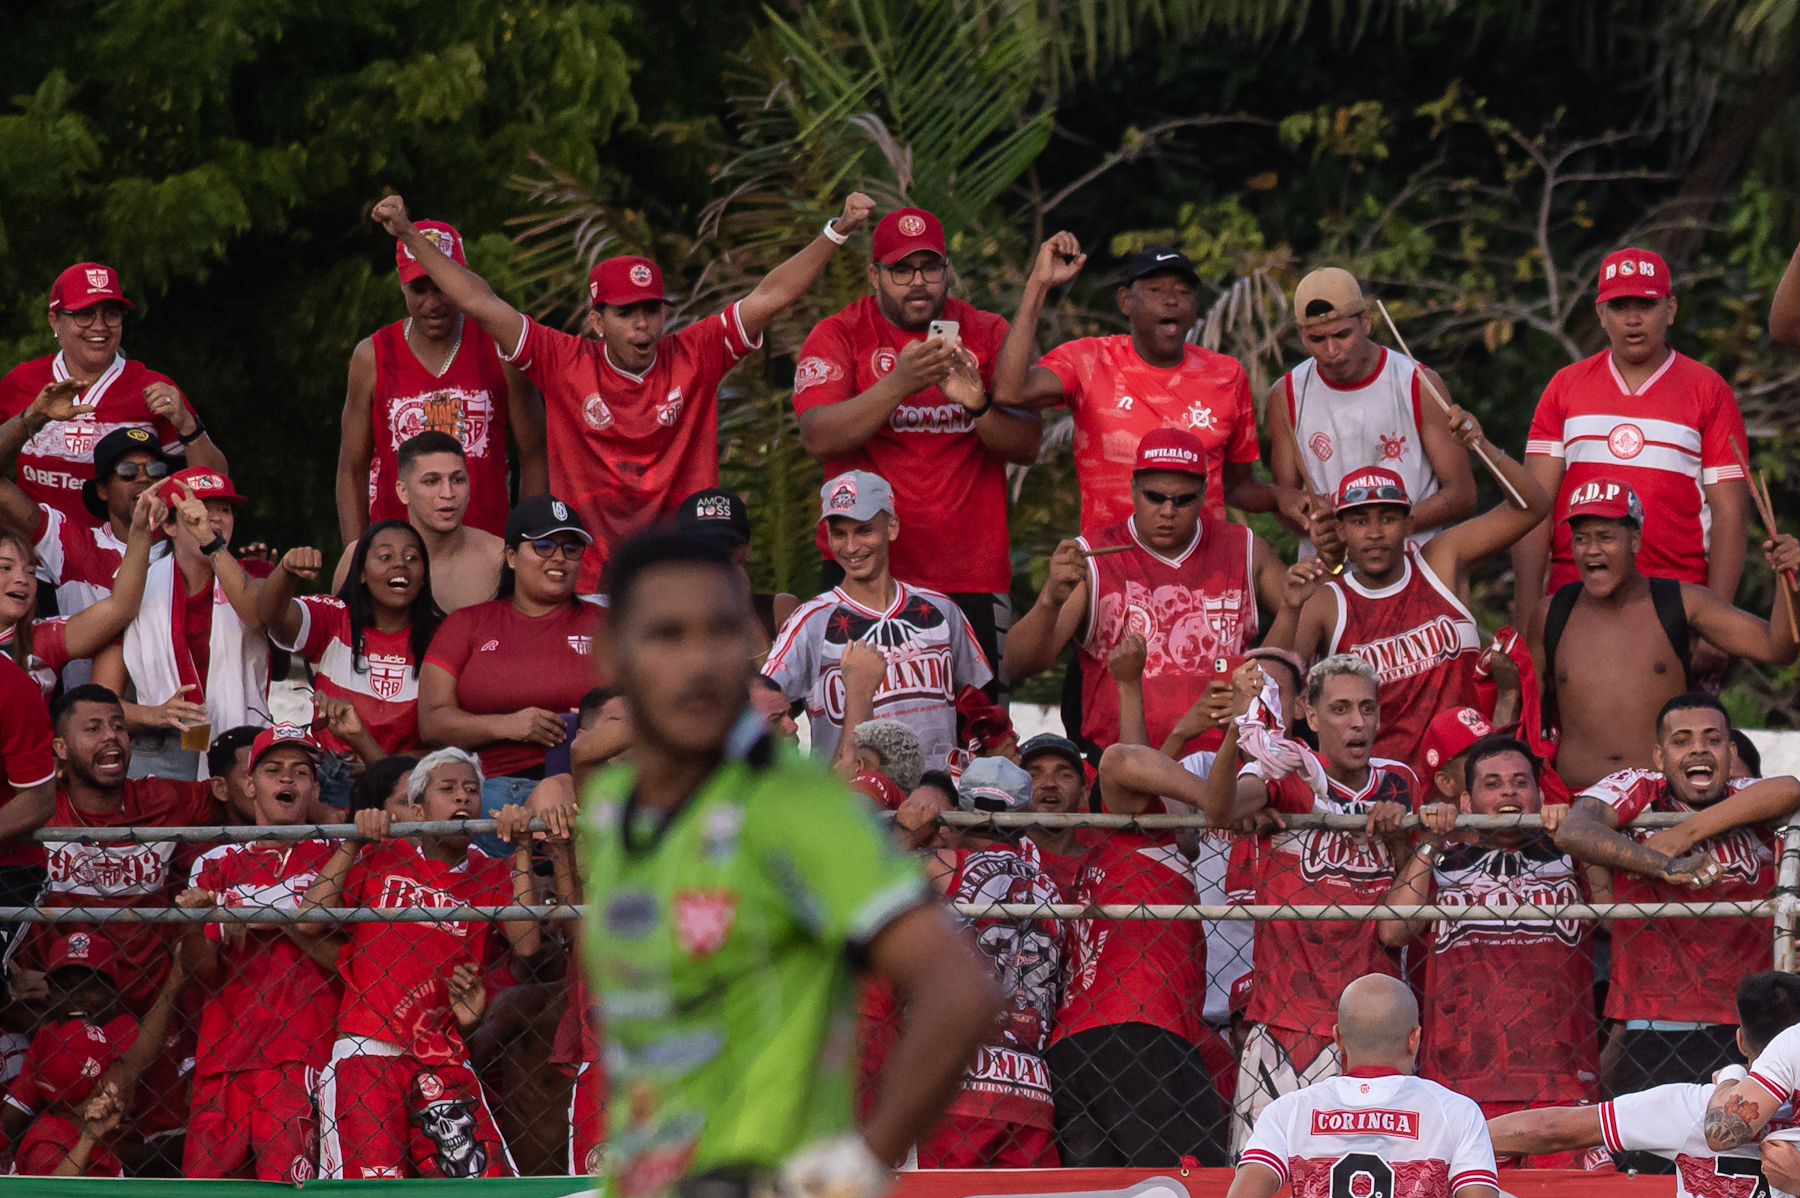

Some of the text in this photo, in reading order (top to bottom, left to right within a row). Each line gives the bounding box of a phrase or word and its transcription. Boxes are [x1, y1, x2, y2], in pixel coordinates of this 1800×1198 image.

[64, 437, 92, 454] CRB
[371, 679, 404, 697] CRB
[1317, 1112, 1412, 1133] CORINGA
